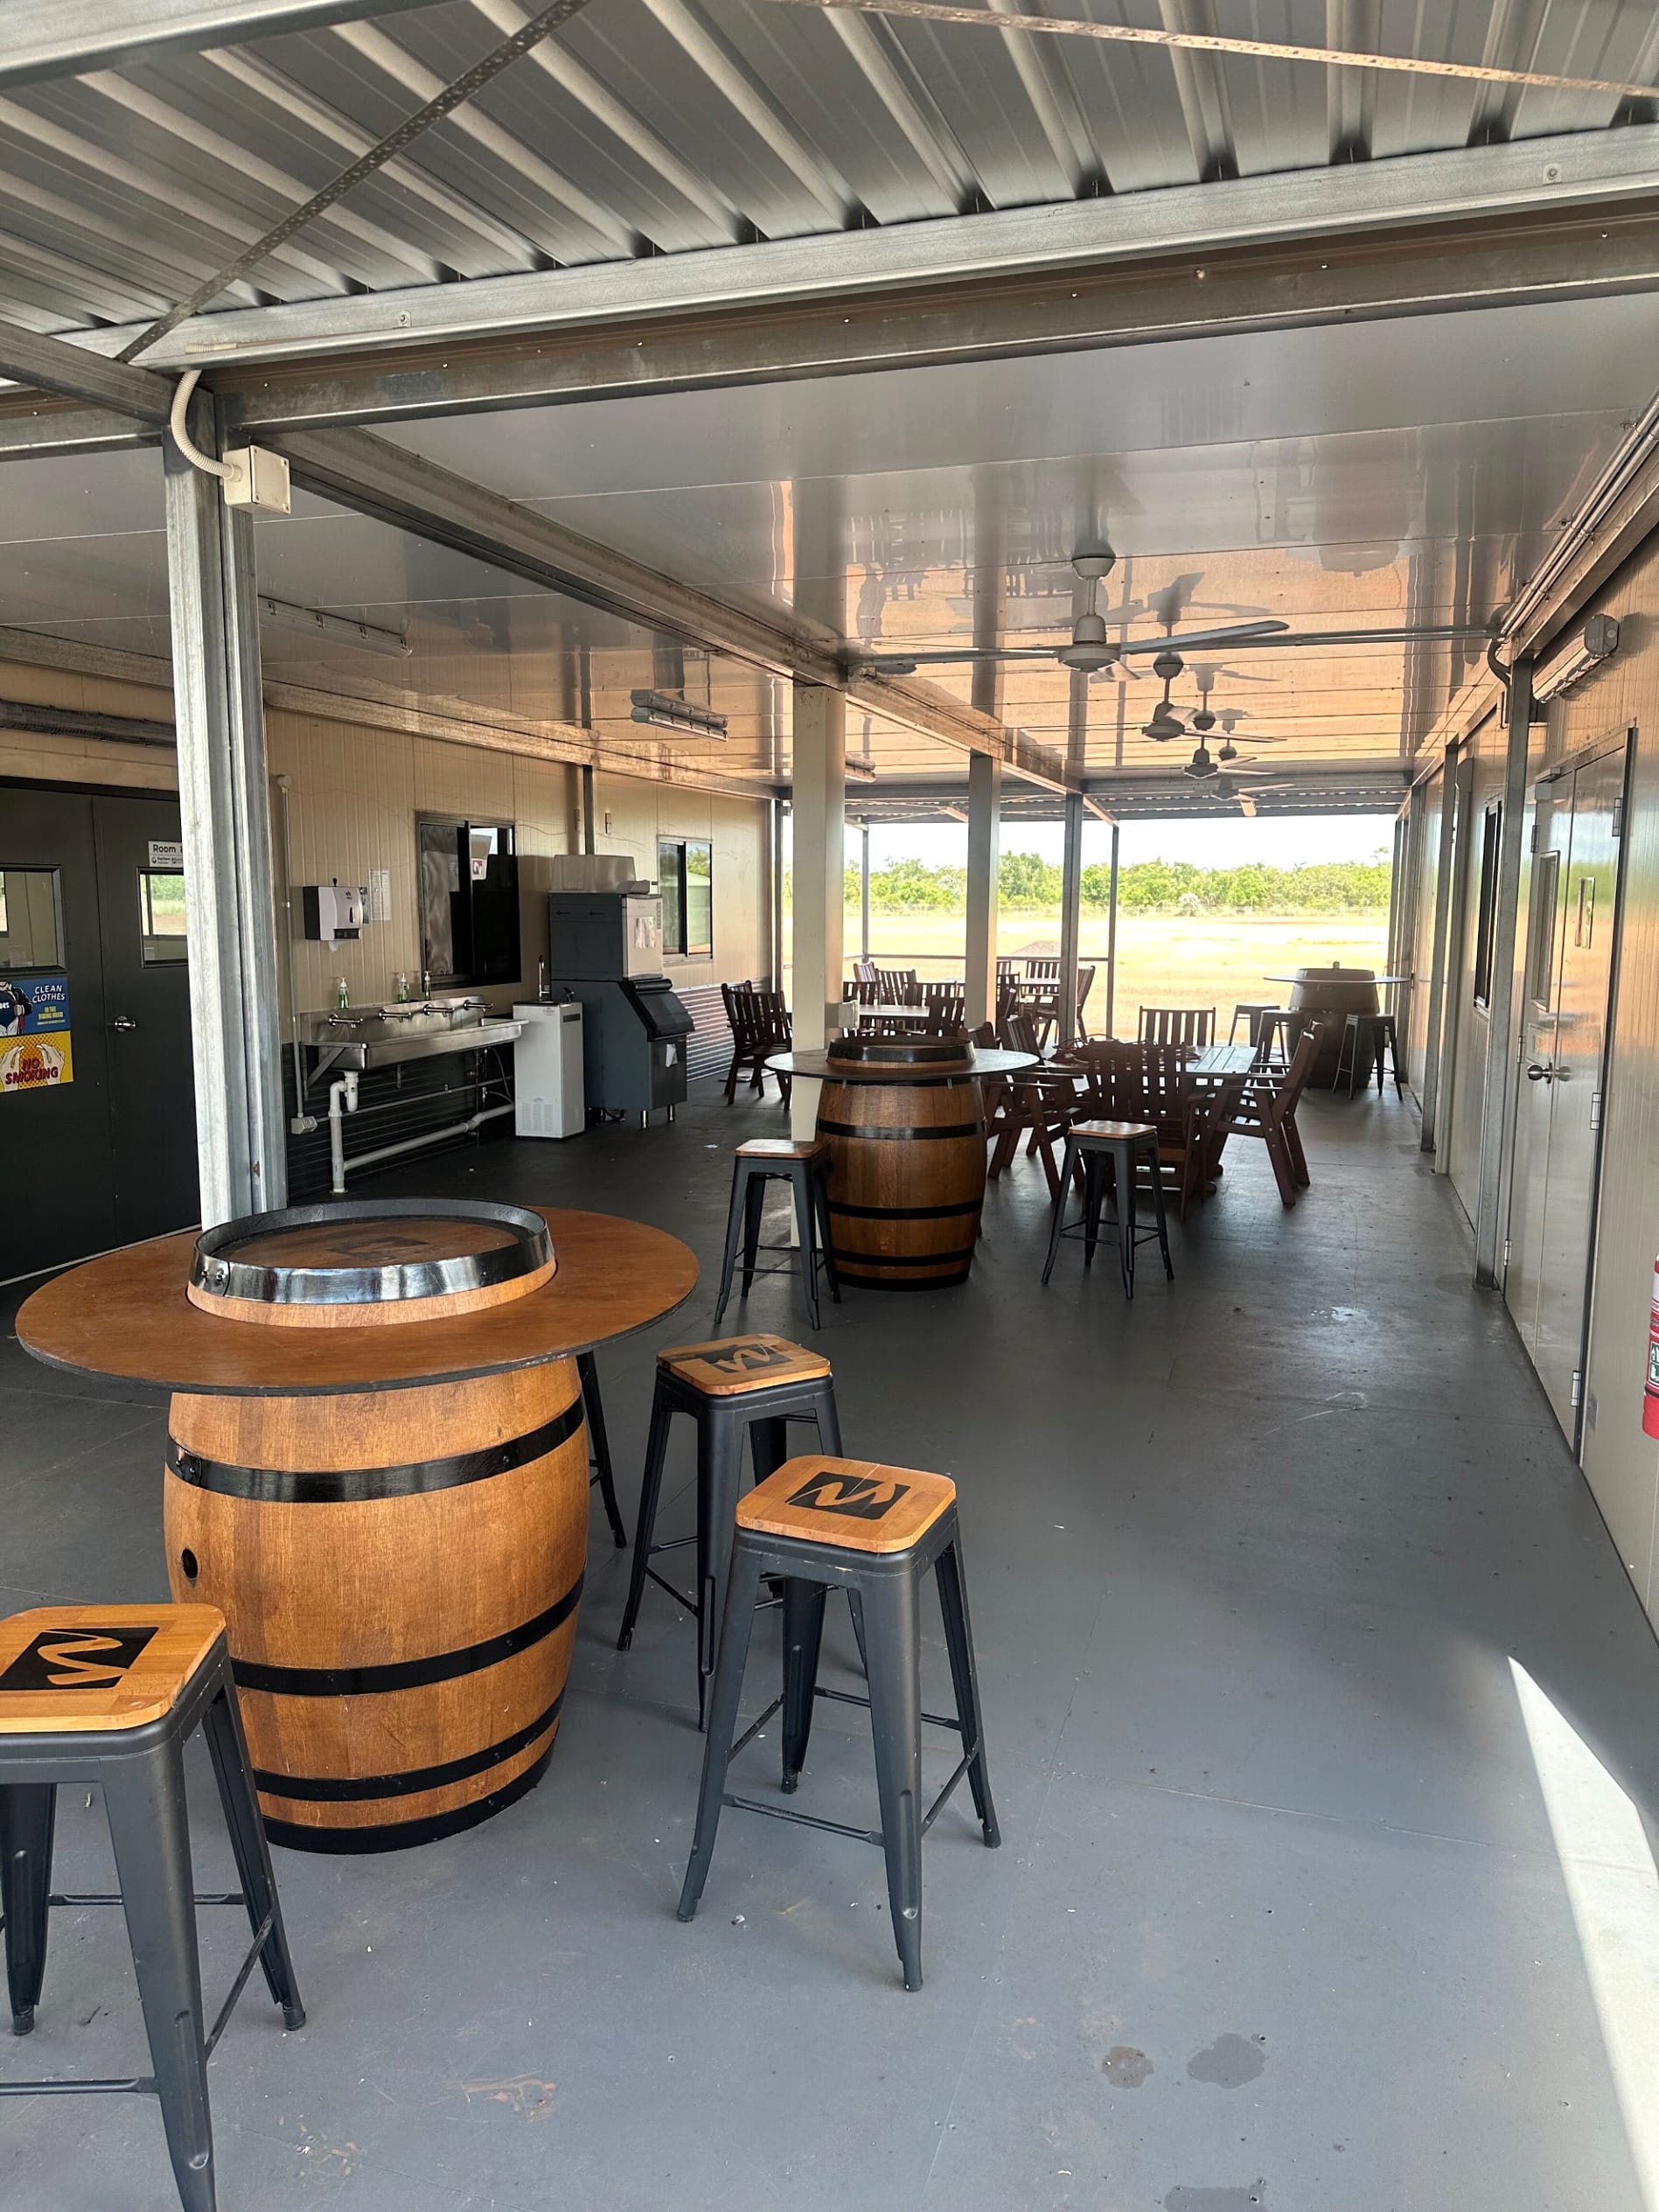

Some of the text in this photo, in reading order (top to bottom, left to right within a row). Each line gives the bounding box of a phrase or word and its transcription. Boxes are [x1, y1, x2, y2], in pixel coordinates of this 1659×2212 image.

[153, 844, 176, 853] Room
[34, 985, 62, 994] CLEAN
[31, 993, 66, 1003] CLOTHES
[22, 1057, 40, 1071] NO
[5, 1066, 59, 1085] SMOKING
